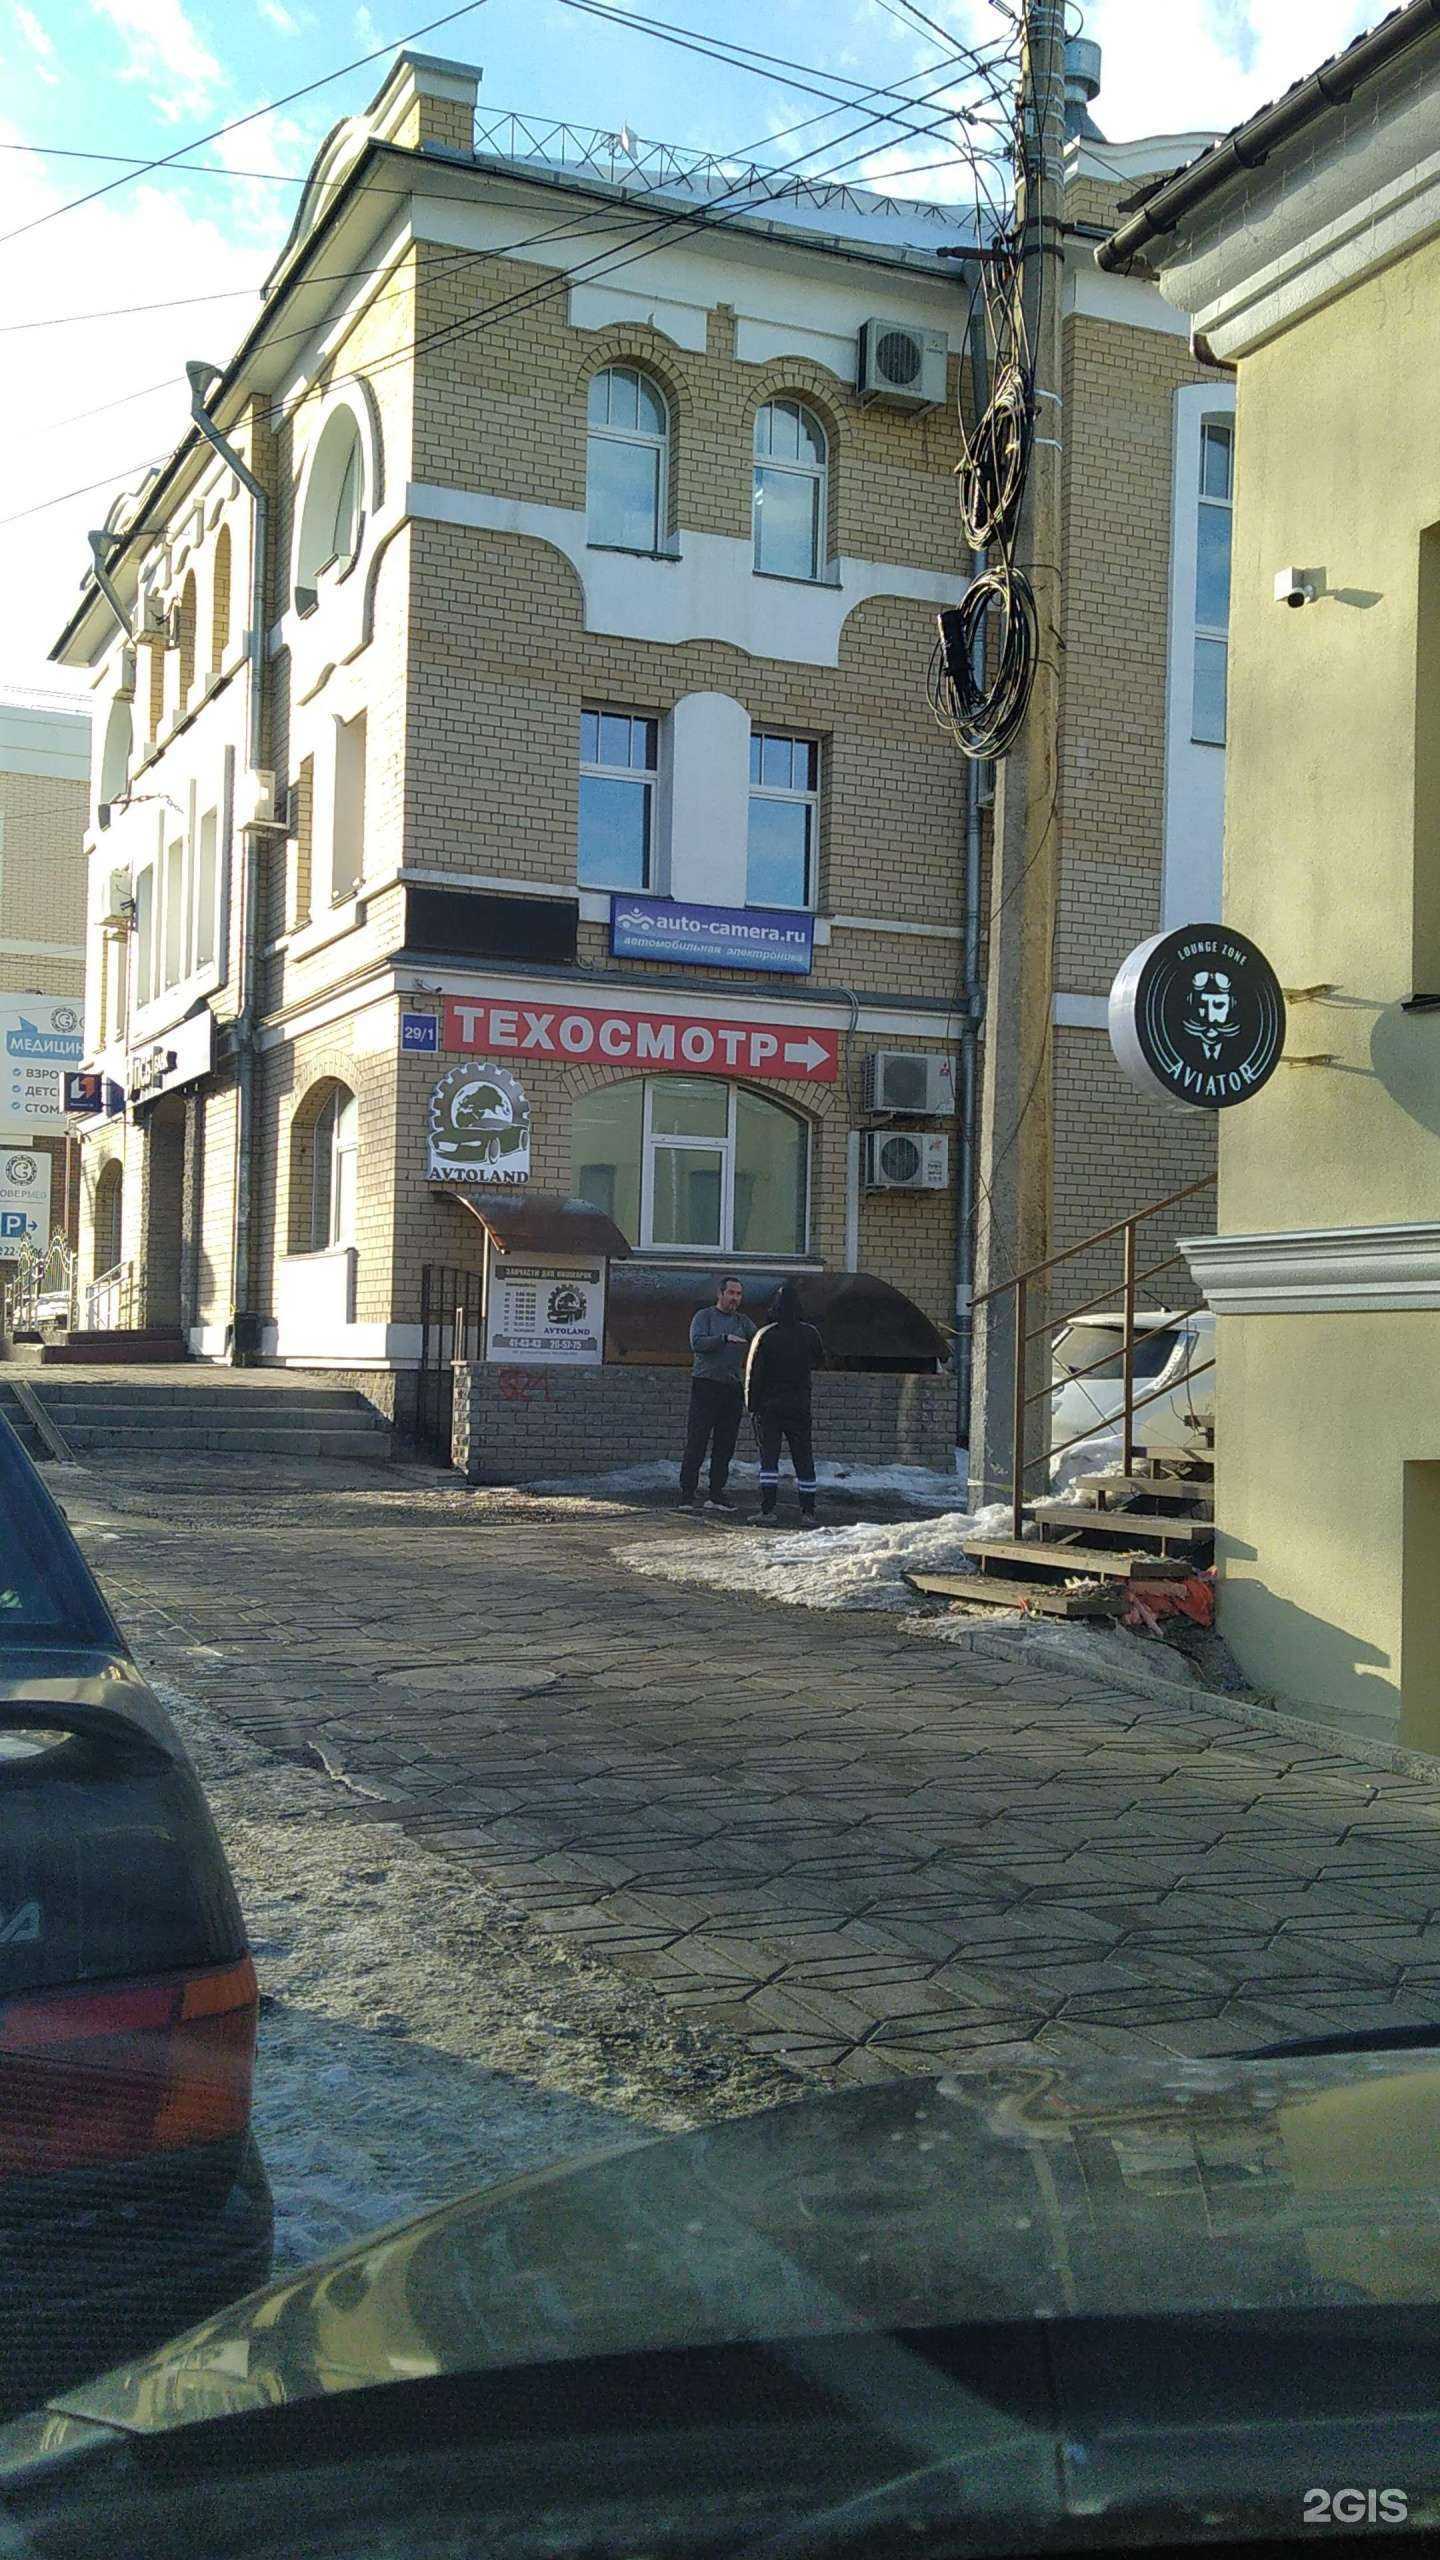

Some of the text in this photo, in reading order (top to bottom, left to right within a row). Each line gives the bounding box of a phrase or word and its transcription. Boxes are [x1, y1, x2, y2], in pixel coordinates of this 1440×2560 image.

[656, 914, 806, 943] auto-camera.ru
[624, 935, 721, 955] автомобильная
[1177, 941, 1248, 966] LOUNGE ZONE
[404, 1025, 434, 1041] 29/1
[453, 1005, 778, 1067] ТЕХОСМОТР
[1168, 1060, 1257, 1096] AVIATOR
[25, 1086, 60, 1097] ДЕТС
[429, 1166, 529, 1185] AVTOLAND
[543, 1327, 591, 1336] AVTOLAND
